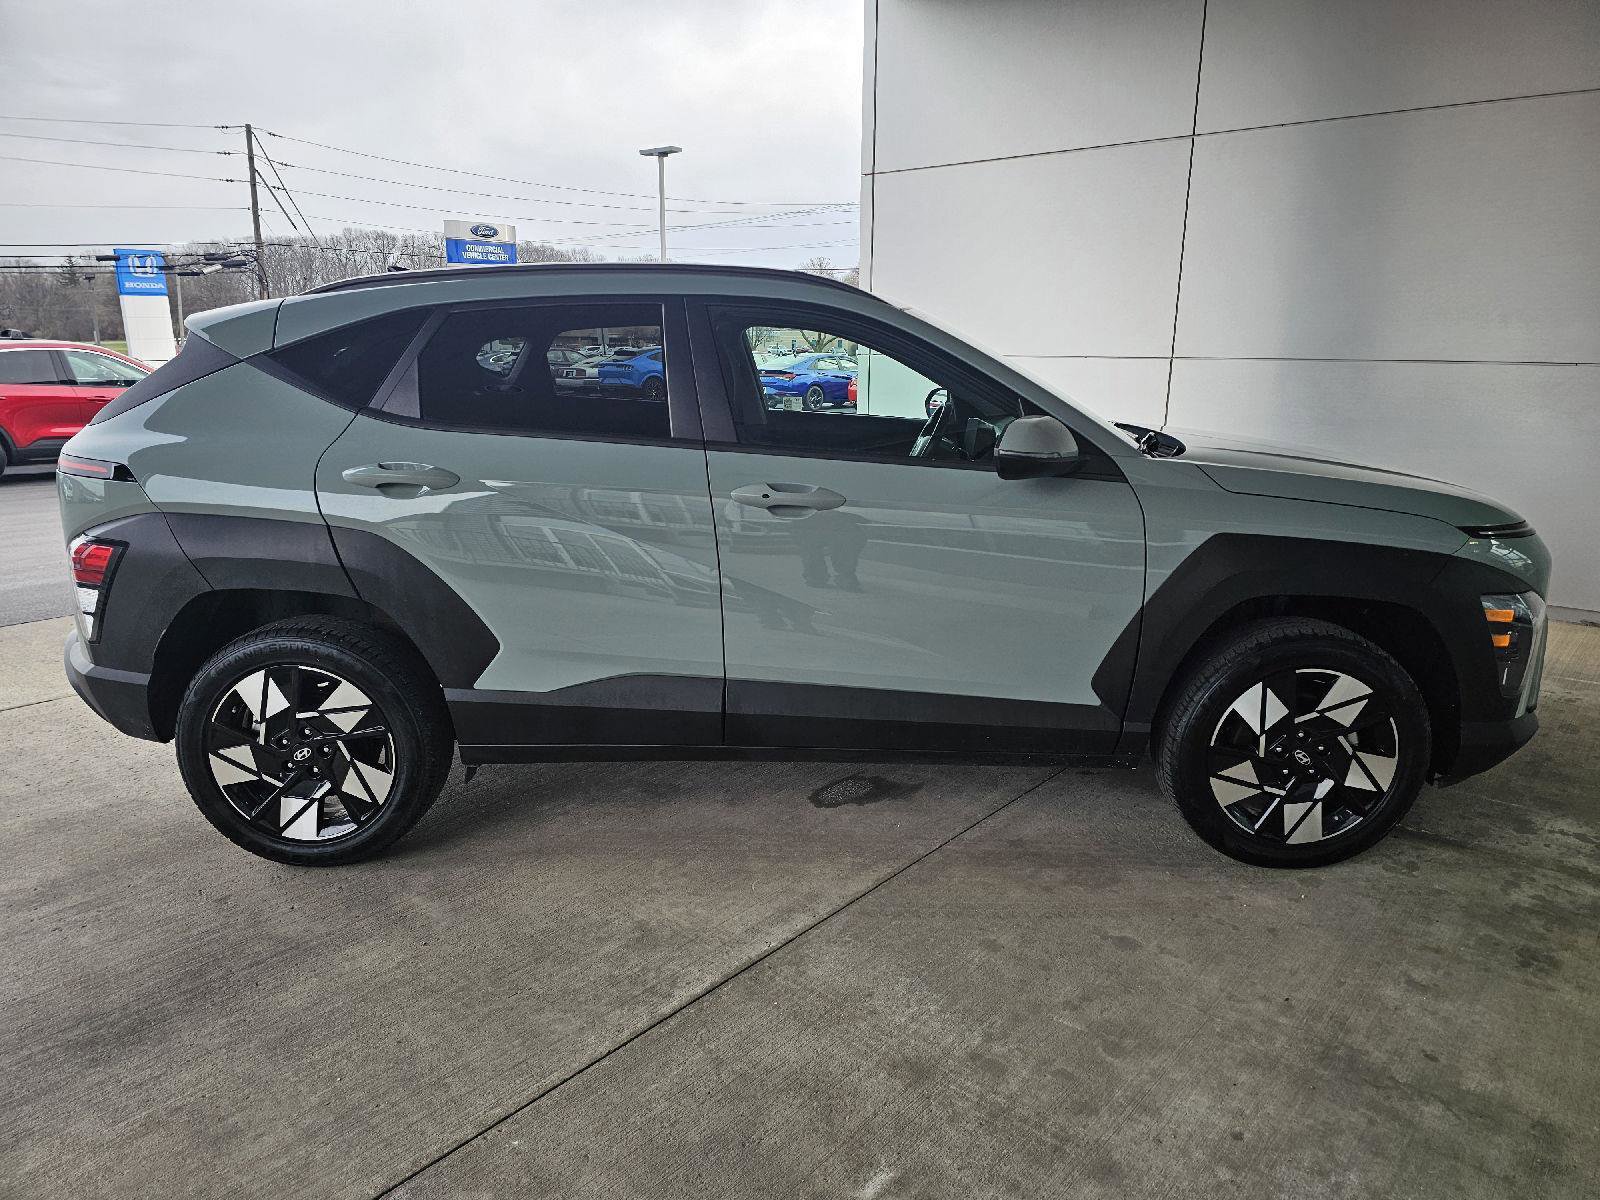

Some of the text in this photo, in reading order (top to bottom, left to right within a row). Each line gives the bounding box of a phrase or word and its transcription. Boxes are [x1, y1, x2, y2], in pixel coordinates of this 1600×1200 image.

[477, 225, 494, 235] Ford
[466, 244, 505, 254] COMMERCIAL
[462, 252, 509, 261] VEHICLE CENTER
[125, 281, 165, 289] HONDA
